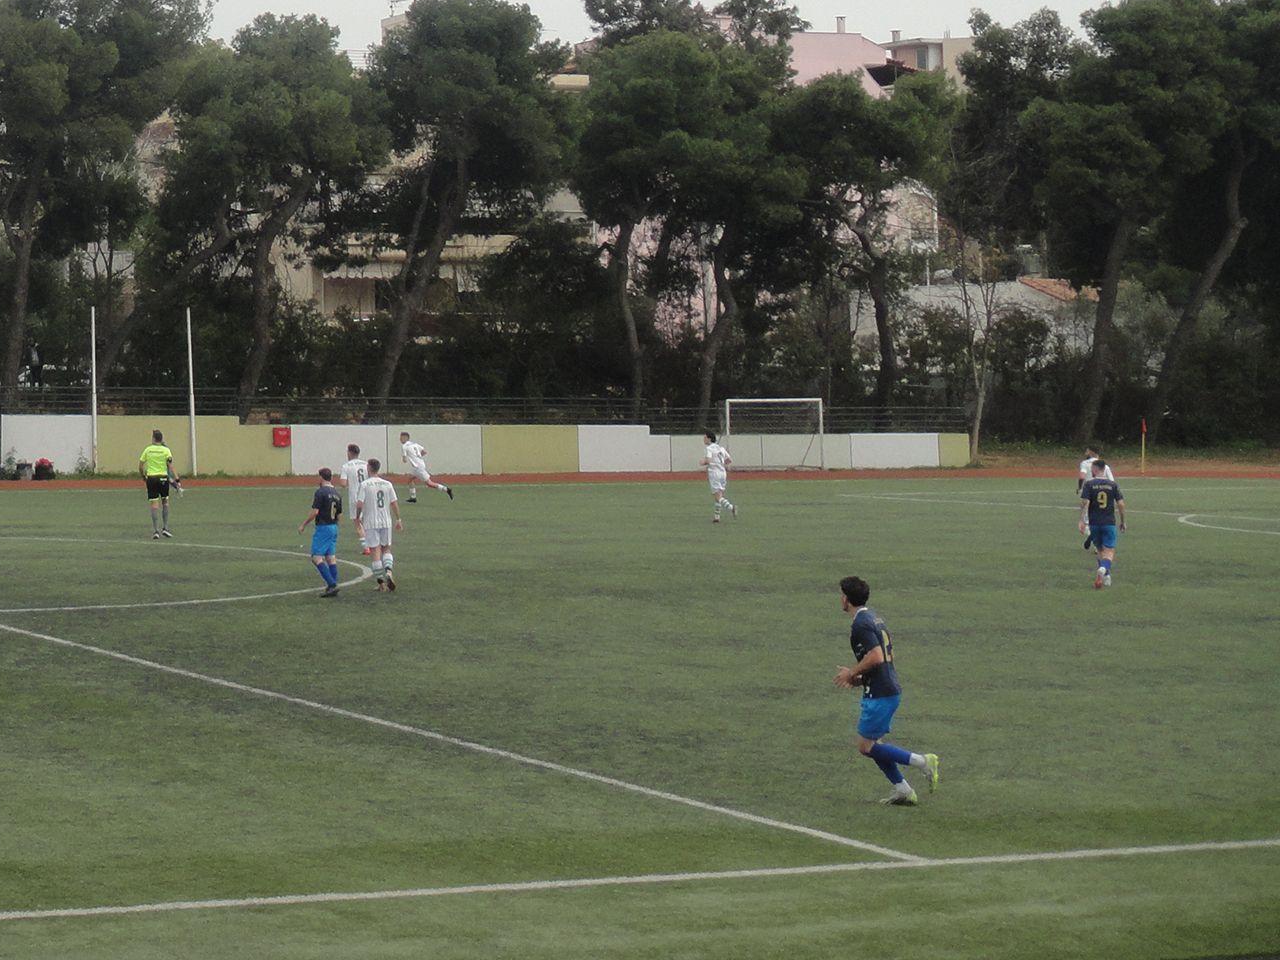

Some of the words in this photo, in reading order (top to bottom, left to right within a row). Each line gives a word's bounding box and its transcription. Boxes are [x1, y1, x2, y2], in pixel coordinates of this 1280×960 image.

[357, 468, 365, 483] 6
[376, 490, 385, 508] 8
[1097, 491, 1108, 509] 9
